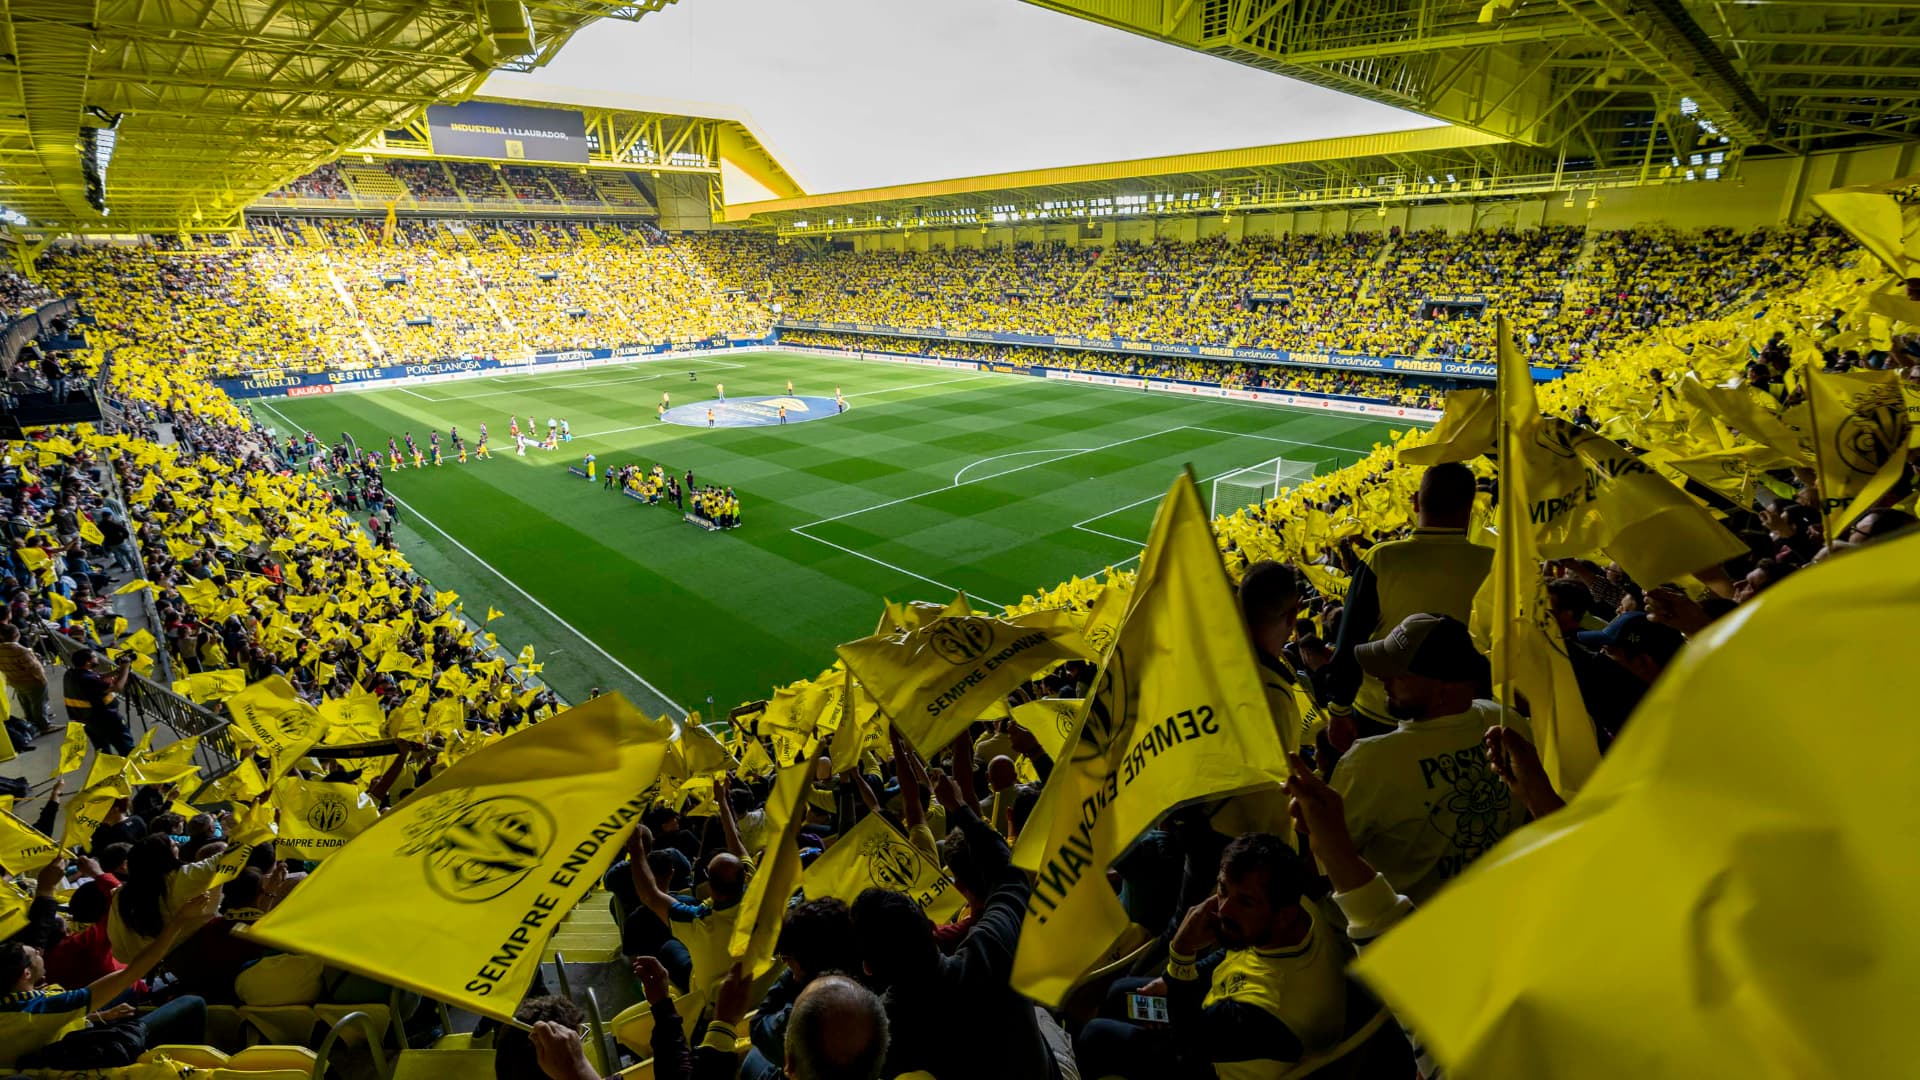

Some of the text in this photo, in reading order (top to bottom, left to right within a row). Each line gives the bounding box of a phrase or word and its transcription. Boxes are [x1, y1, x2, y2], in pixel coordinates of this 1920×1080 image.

[451, 123, 507, 135] INDUSTRIAL
[514, 128, 569, 141] LLAURADOR,
[1199, 346, 1233, 357] PAMESA
[1289, 352, 1329, 364] PAMESA
[1394, 359, 1442, 373] PAMESA
[328, 368, 382, 382] BESTILE
[291, 385, 321, 396] LALIGA
[927, 631, 1050, 717] SEMPRE ENDAVAN
[465, 784, 655, 996] SEMPRE ENDAVAN
